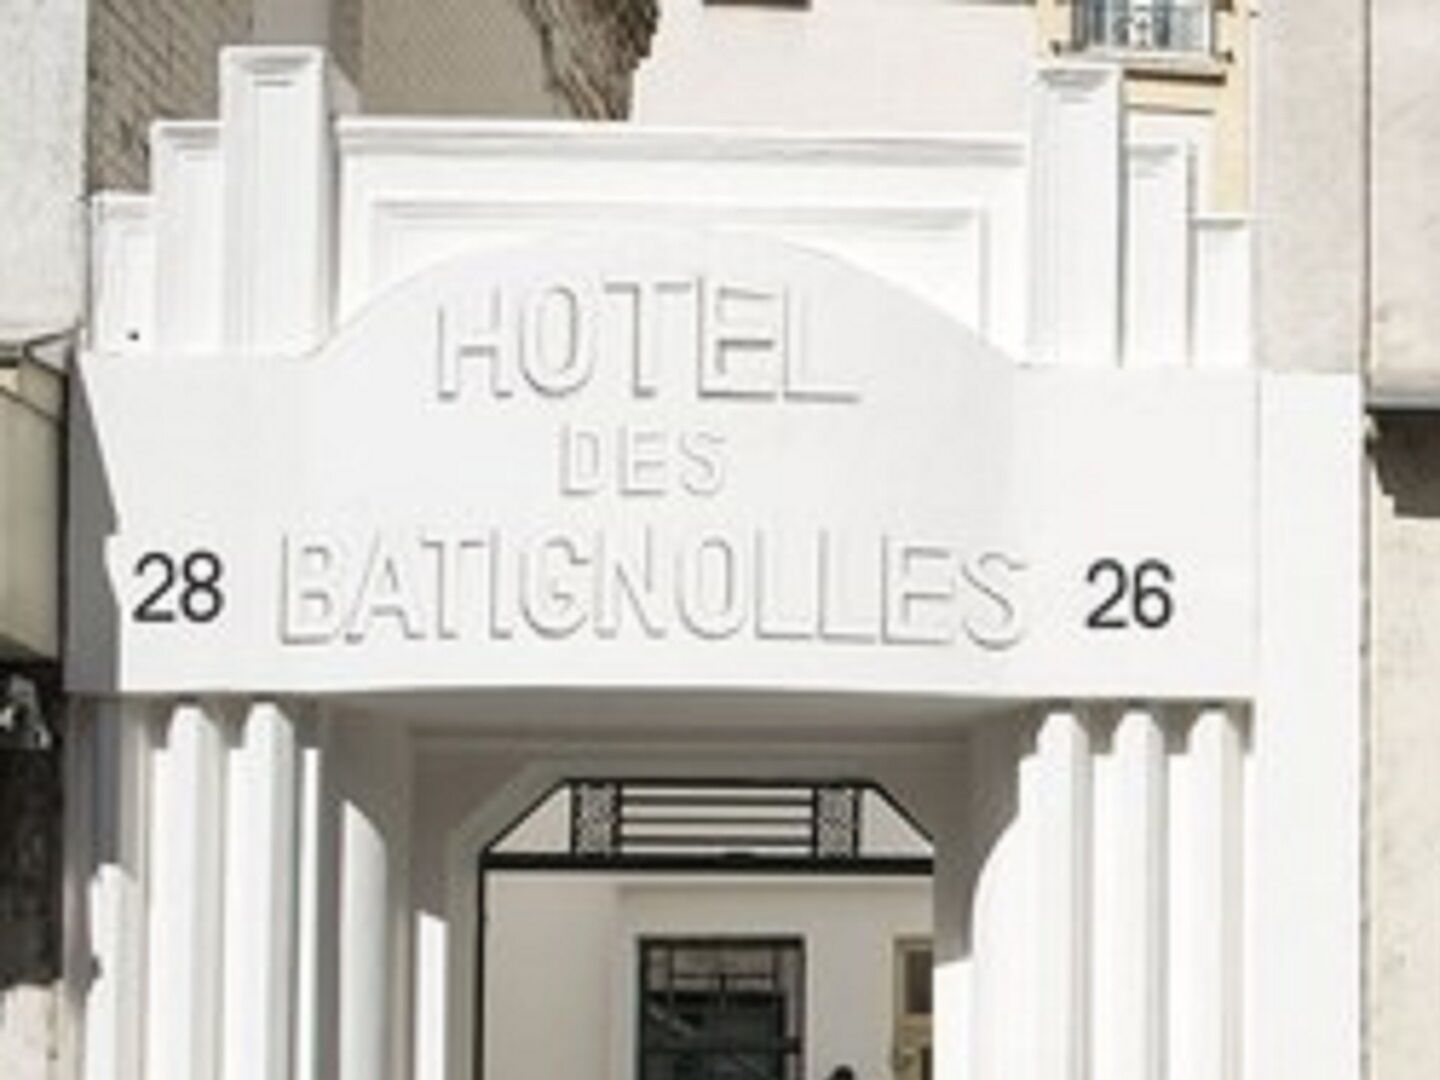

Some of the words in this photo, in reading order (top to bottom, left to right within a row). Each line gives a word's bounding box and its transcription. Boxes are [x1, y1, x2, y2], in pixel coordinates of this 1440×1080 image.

[434, 274, 861, 402] HOTEL
[556, 422, 728, 498] DES
[131, 551, 225, 624] 28
[276, 527, 1027, 652] BATIGNOLLES
[1083, 557, 1176, 631] 26
